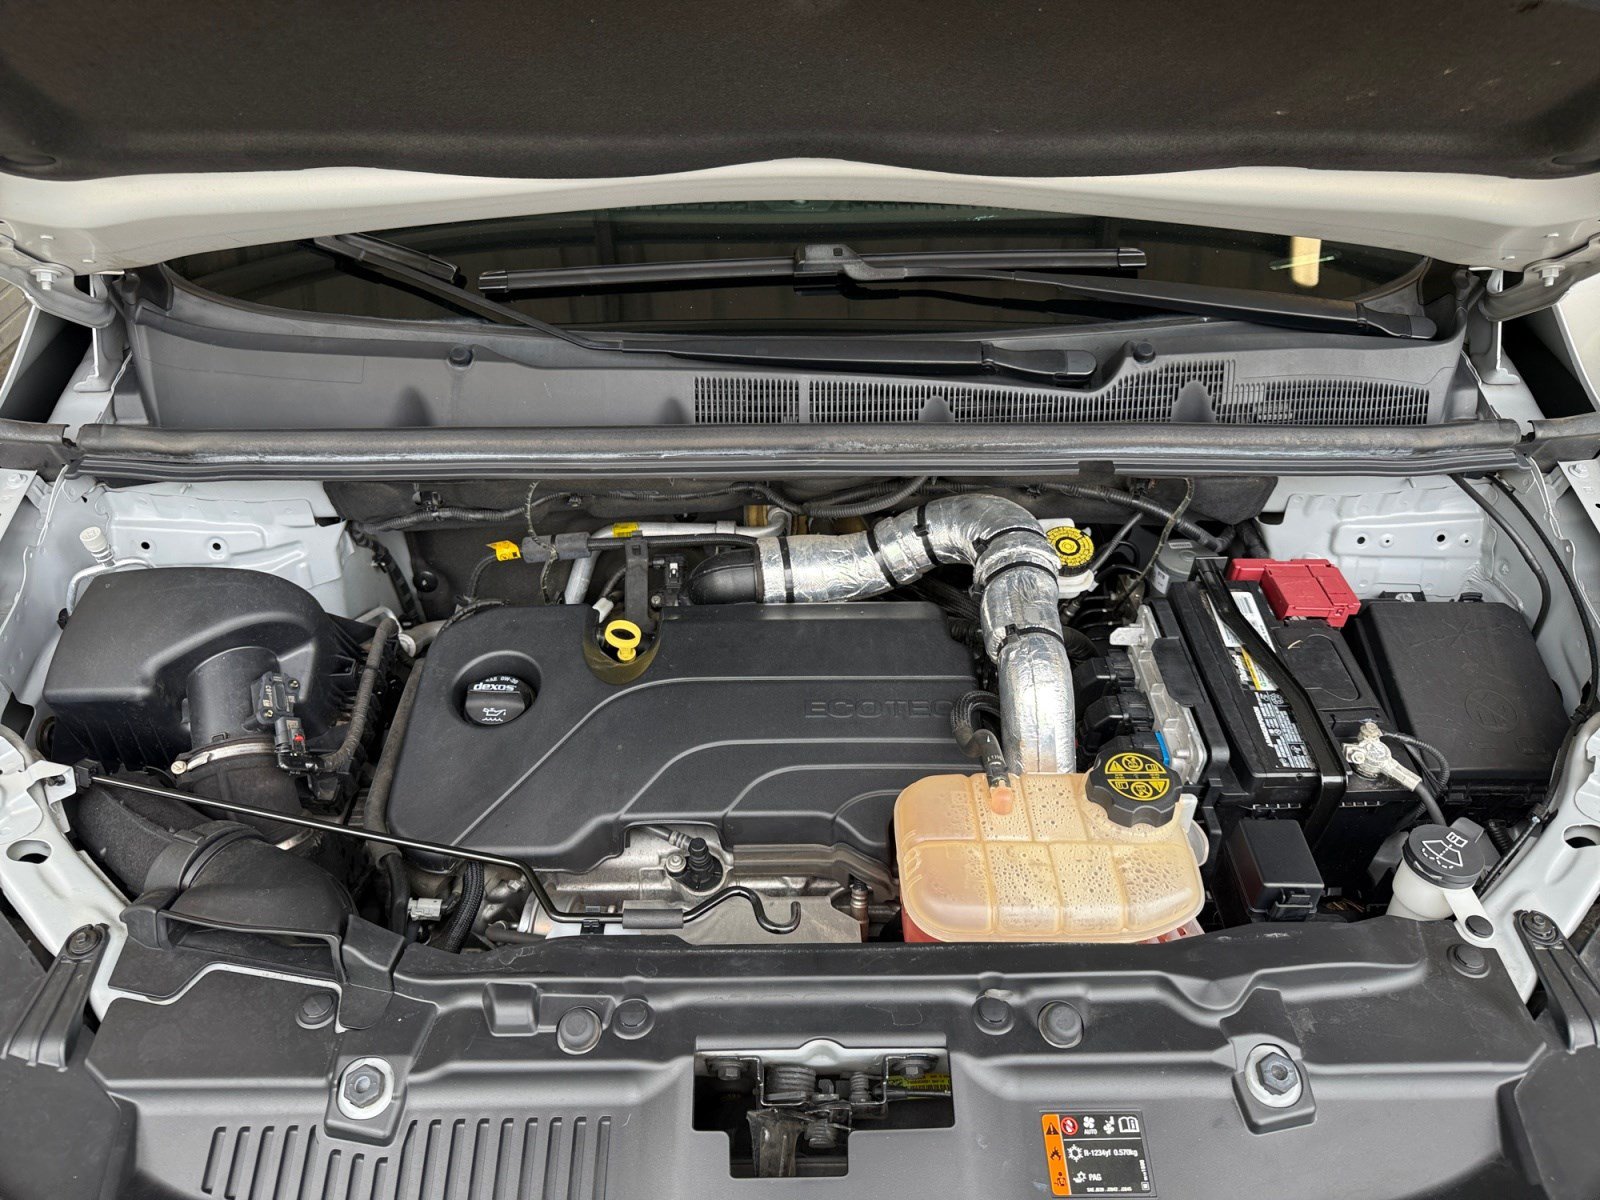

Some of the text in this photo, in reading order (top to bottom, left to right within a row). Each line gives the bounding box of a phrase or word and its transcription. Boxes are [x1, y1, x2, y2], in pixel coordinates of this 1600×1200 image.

[473, 682, 515, 691] dexos
[804, 699, 953, 718] ECOTEC
[1088, 1173, 1102, 1181] PAG
